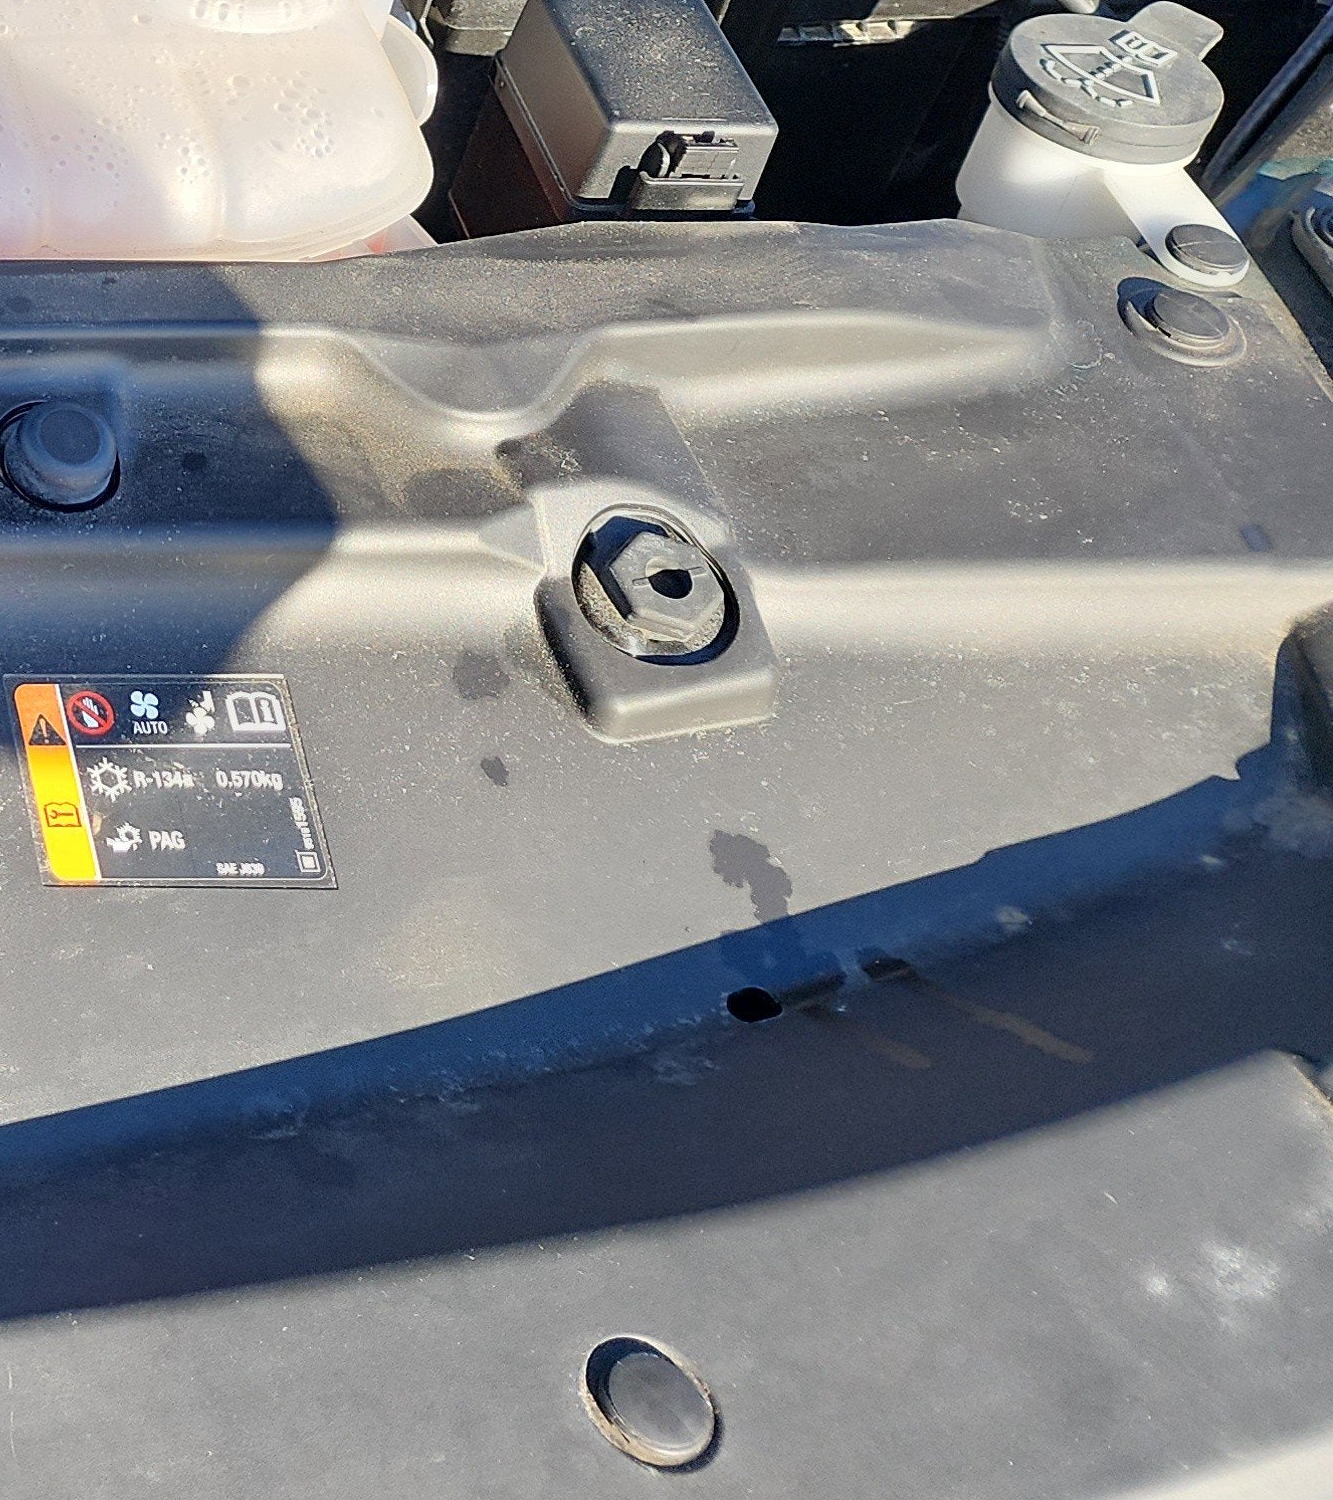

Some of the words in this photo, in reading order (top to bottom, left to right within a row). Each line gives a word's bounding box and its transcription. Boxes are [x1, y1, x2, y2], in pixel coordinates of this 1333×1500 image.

[133, 720, 168, 735] AUTO
[133, 770, 195, 789] R-134a
[215, 769, 284, 791] 0.570kg
[148, 830, 186, 850] PAG
